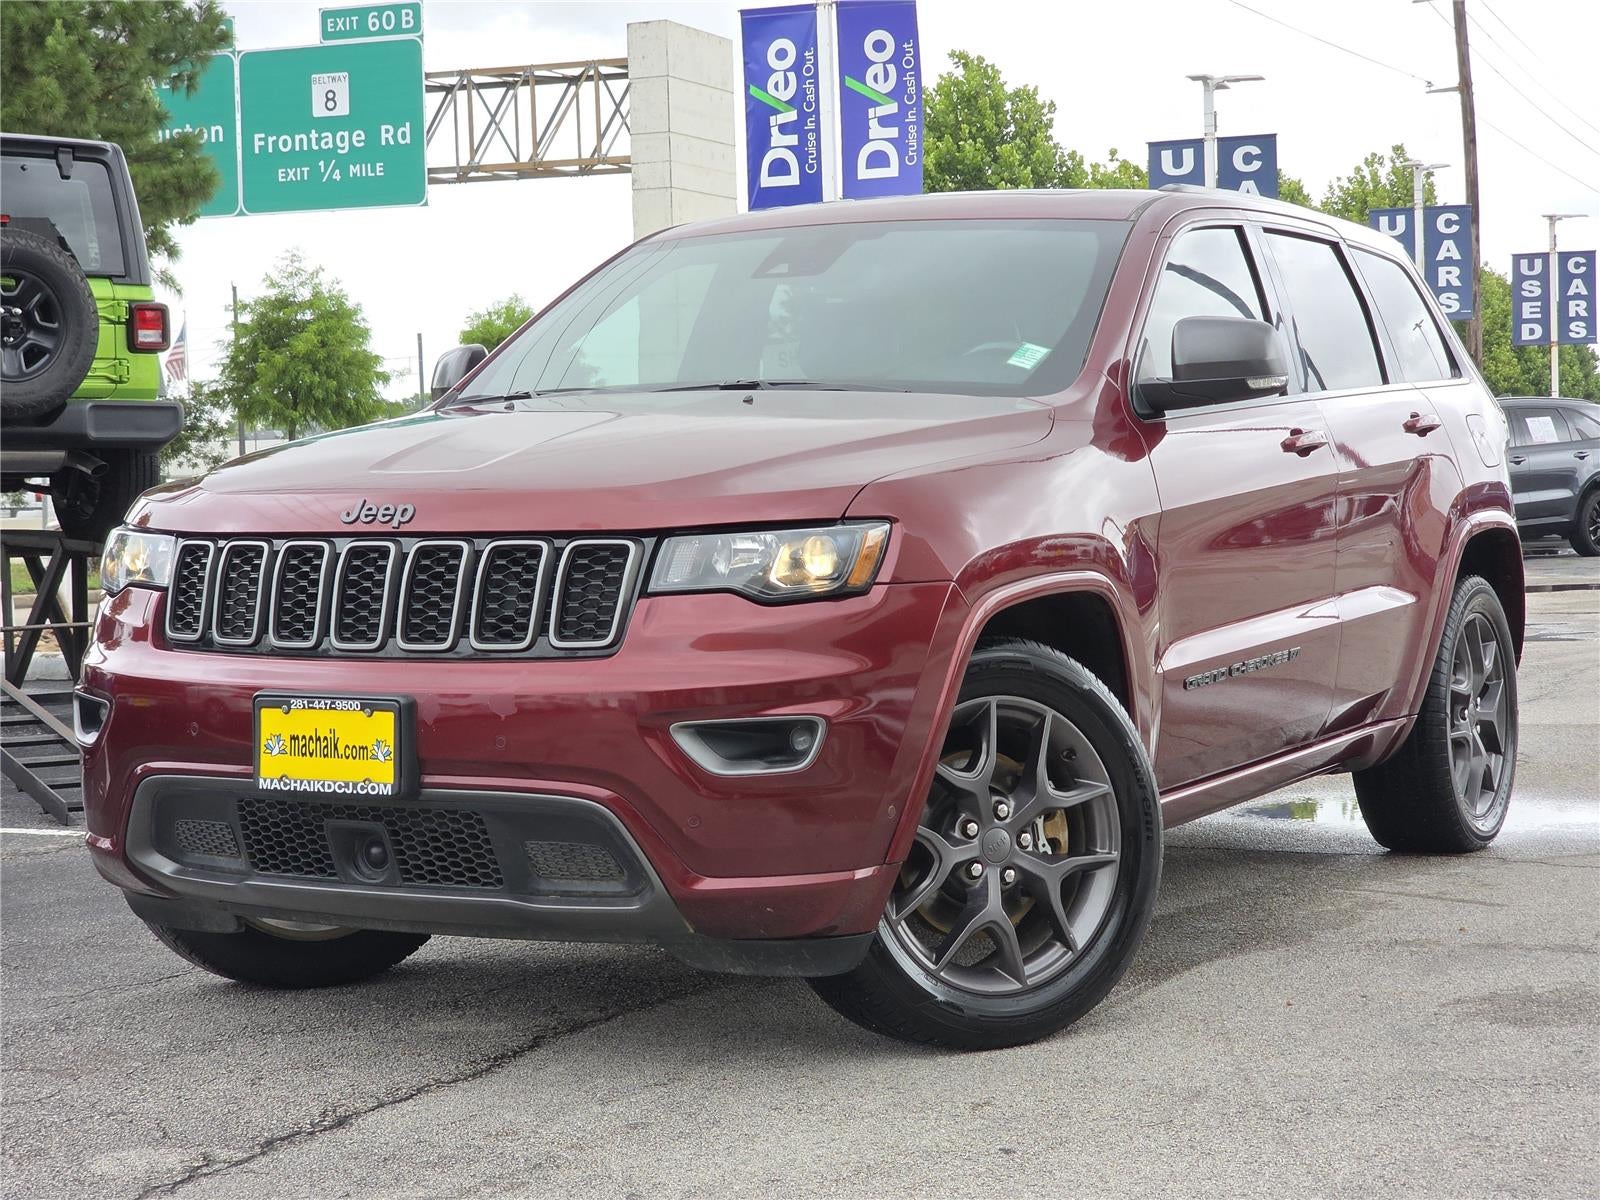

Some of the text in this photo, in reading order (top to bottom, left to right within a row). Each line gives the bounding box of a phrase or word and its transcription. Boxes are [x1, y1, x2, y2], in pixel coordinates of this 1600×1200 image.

[327, 16, 359, 32] EXIT
[312, 75, 348, 85] BELTWAY
[324, 89, 337, 112] 8
[802, 47, 817, 174] Cruise In. Cash Out.
[902, 39, 917, 166] Cruise In. Cash Out.
[253, 122, 411, 154] Frontage Rd
[278, 167, 310, 182] EXIT
[349, 163, 384, 178] MILE
[1435, 213, 1462, 314] CARS
[1520, 258, 1543, 341] USED
[1566, 256, 1589, 339] CARS
[340, 498, 416, 529] Jeep
[290, 699, 361, 711] 281-447-9500
[289, 728, 369, 761] machaik.com
[258, 778, 392, 795] MACHAIKDCJ.COM
